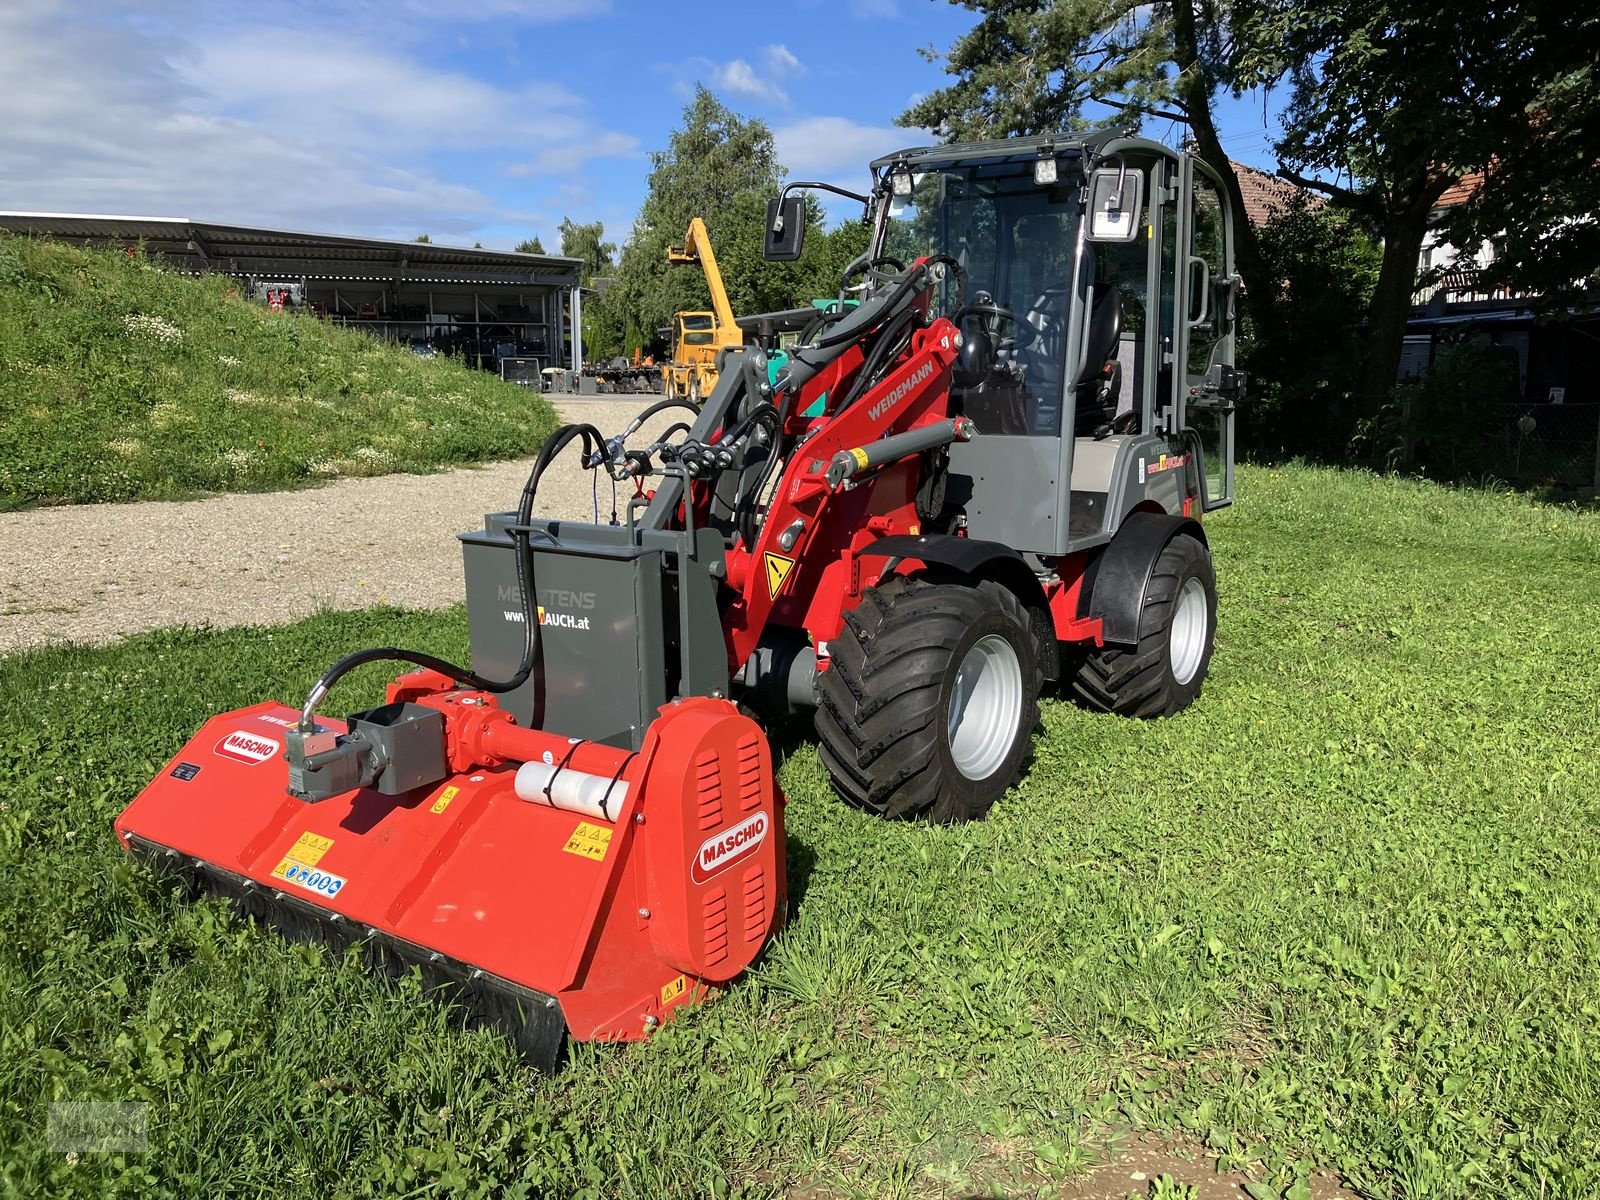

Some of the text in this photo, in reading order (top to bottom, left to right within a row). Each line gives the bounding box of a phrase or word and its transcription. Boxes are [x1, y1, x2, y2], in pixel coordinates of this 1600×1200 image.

[867, 359, 933, 422] WEIDEMANN
[497, 584, 596, 609] MERTENS
[226, 735, 275, 756] MASCHIO
[703, 818, 764, 866] MASCHIO
